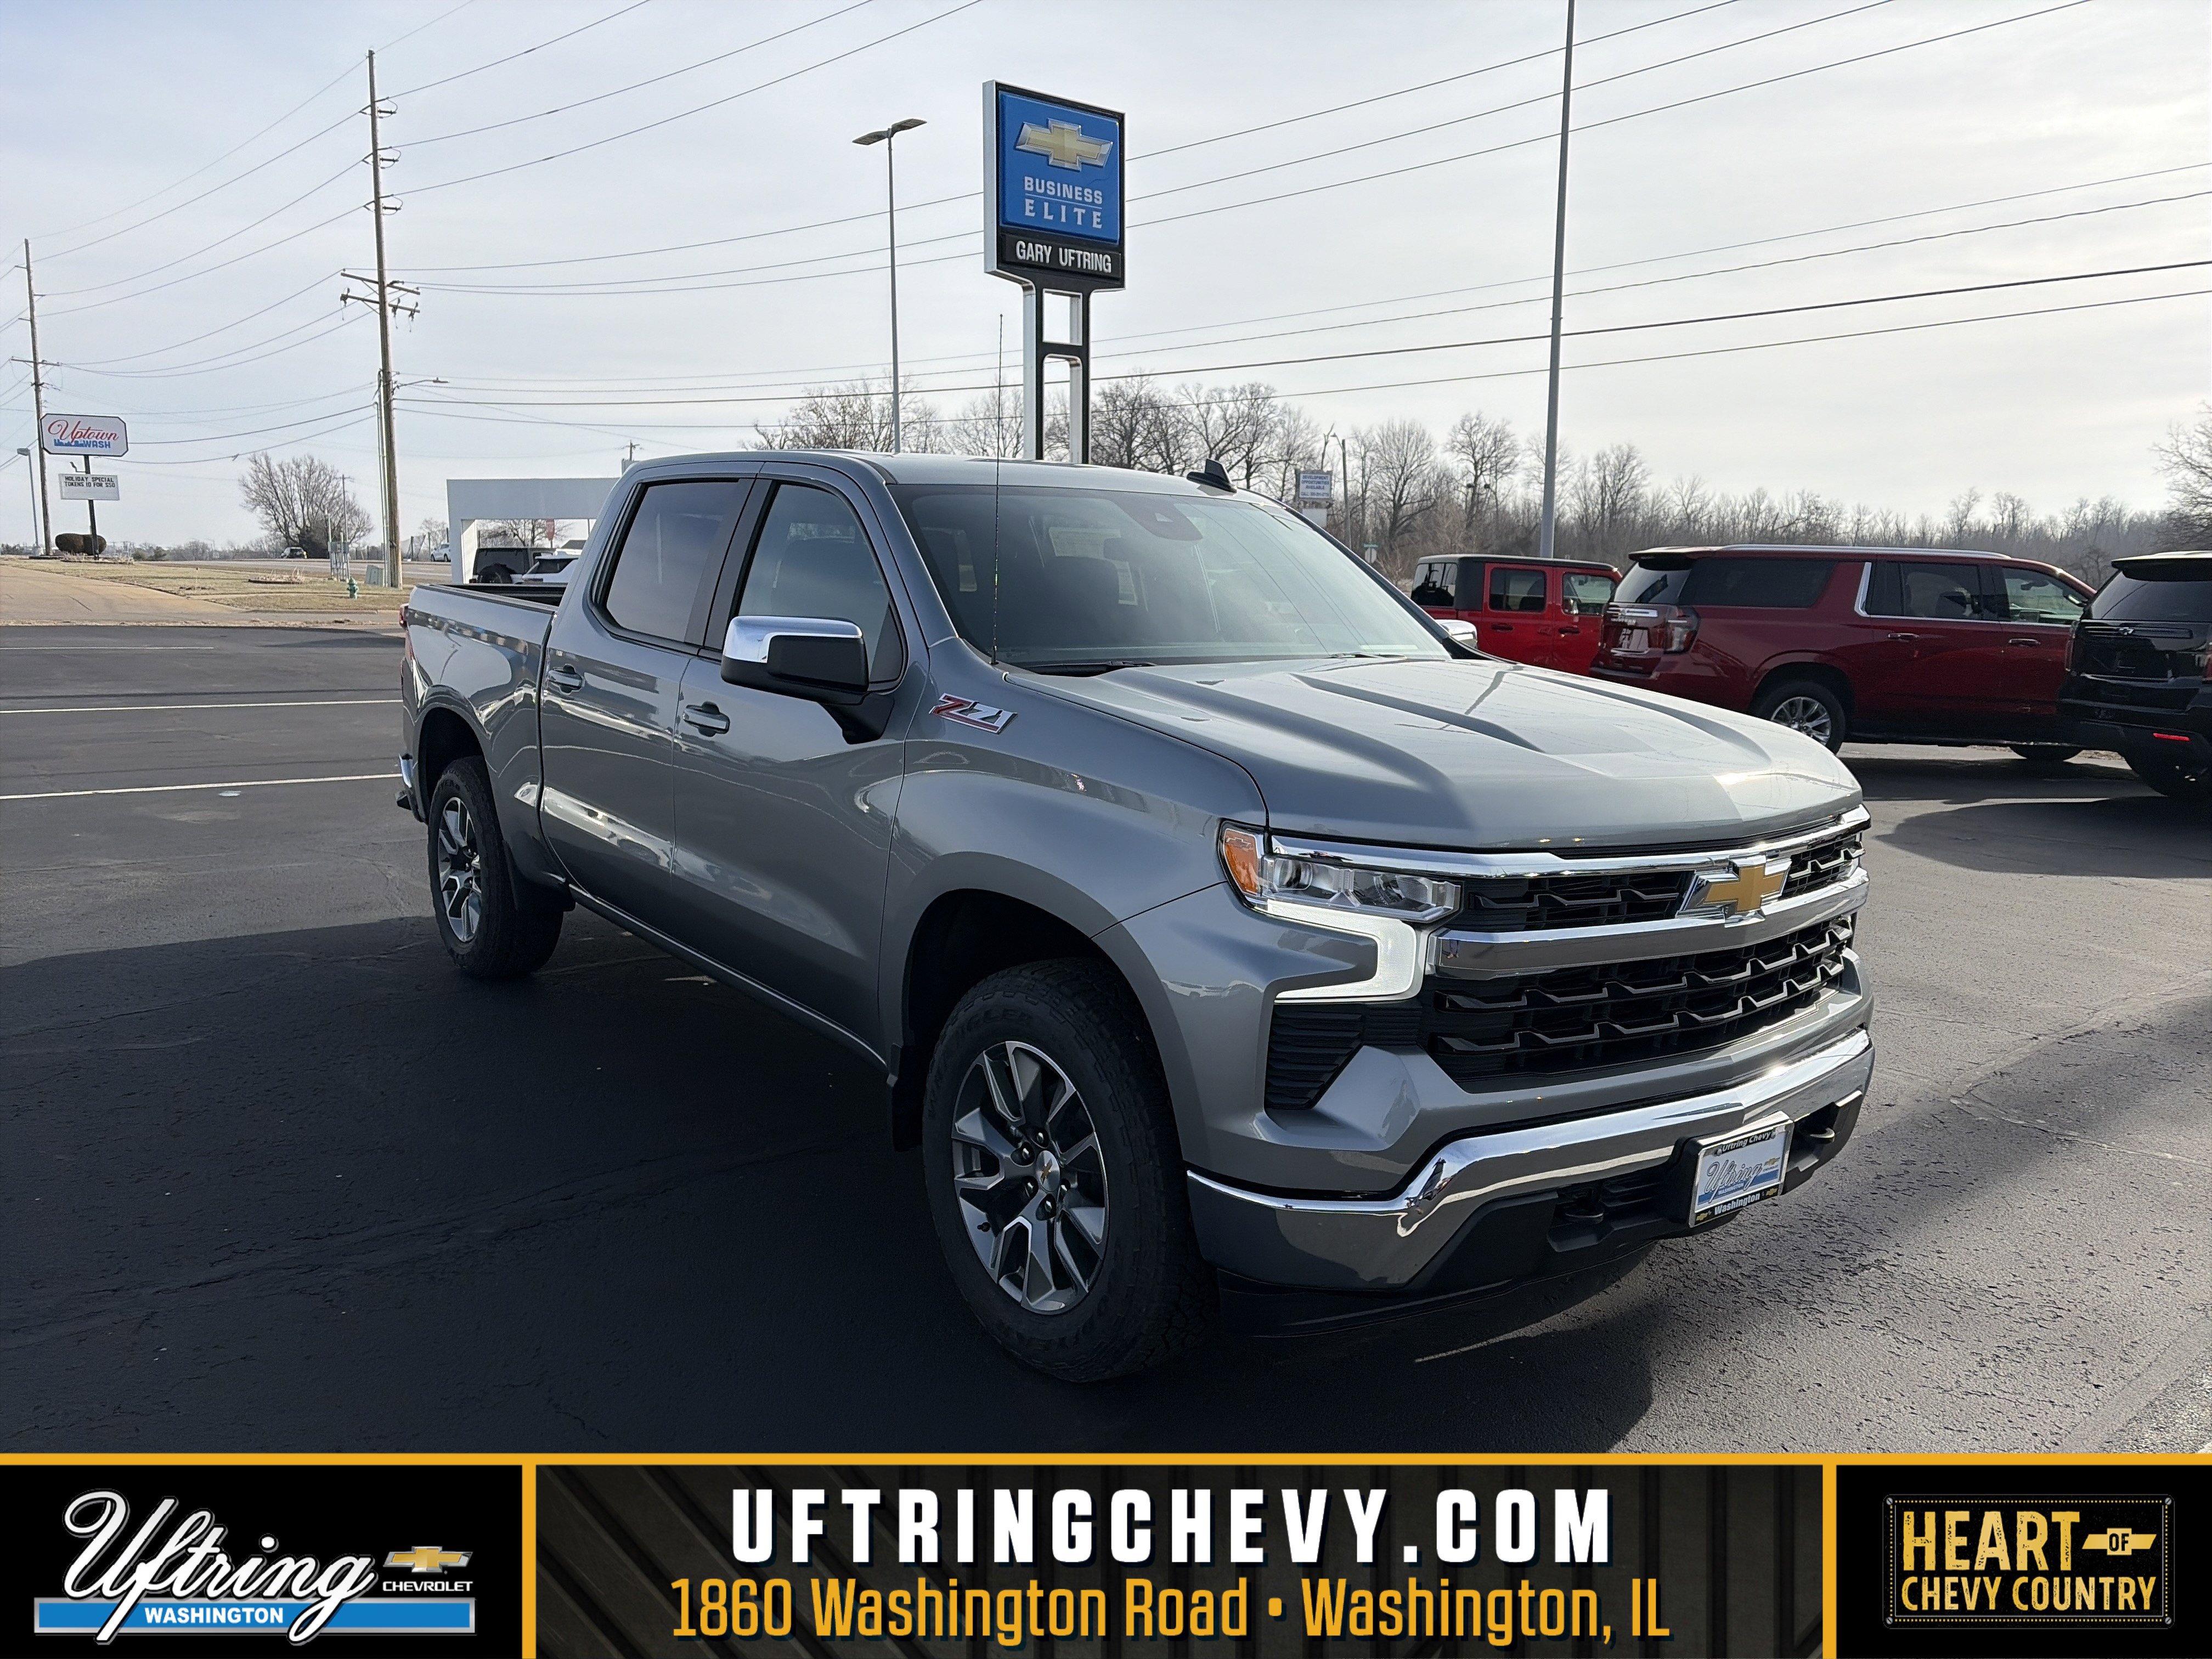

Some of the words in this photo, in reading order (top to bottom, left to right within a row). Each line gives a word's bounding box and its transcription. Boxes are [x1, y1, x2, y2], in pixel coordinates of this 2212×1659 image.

[1024, 176, 1103, 205] BUSINESS
[1025, 198, 1103, 229] ELITE
[1016, 240, 1052, 264] GARY
[1059, 247, 1112, 273] UFTRING
[48, 419, 119, 443] Uptown
[83, 439, 111, 448] WASH
[928, 693, 1018, 734] Z71
[1749, 1132, 1771, 1143] Chevy
[1705, 1160, 1762, 1203] Uftring
[1718, 1183, 1744, 1195] WASHINGTON
[1714, 1192, 1760, 1215] Washington
